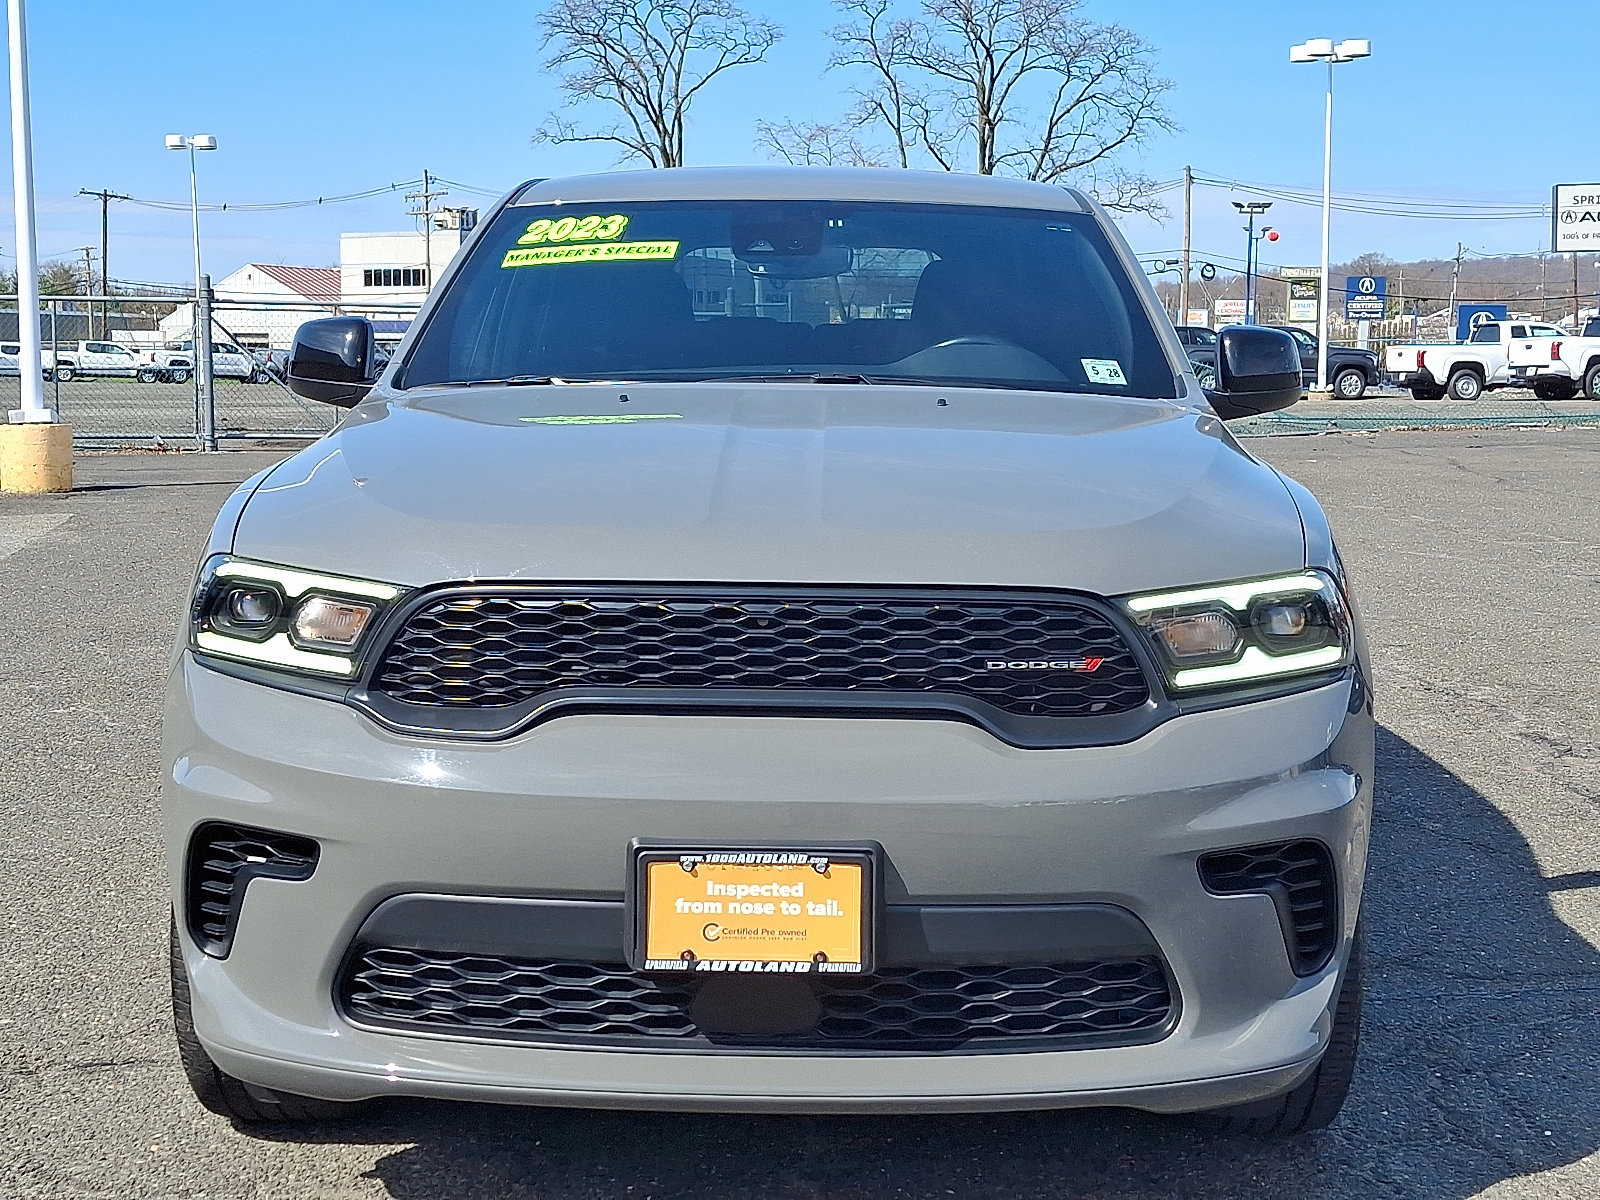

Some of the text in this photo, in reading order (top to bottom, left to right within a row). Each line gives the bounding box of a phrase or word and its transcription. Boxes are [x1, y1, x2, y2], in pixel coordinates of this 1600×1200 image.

[517, 214, 629, 245] 2023
[506, 245, 672, 263] MANAGER'S SPECIAL
[1091, 366, 1120, 377] 5 28
[986, 661, 1088, 670] DODGE
[706, 880, 804, 900] Inspected
[675, 898, 844, 917] from nose to tail.
[721, 927, 759, 936] Certified
[695, 960, 811, 974] AUTOLAND
